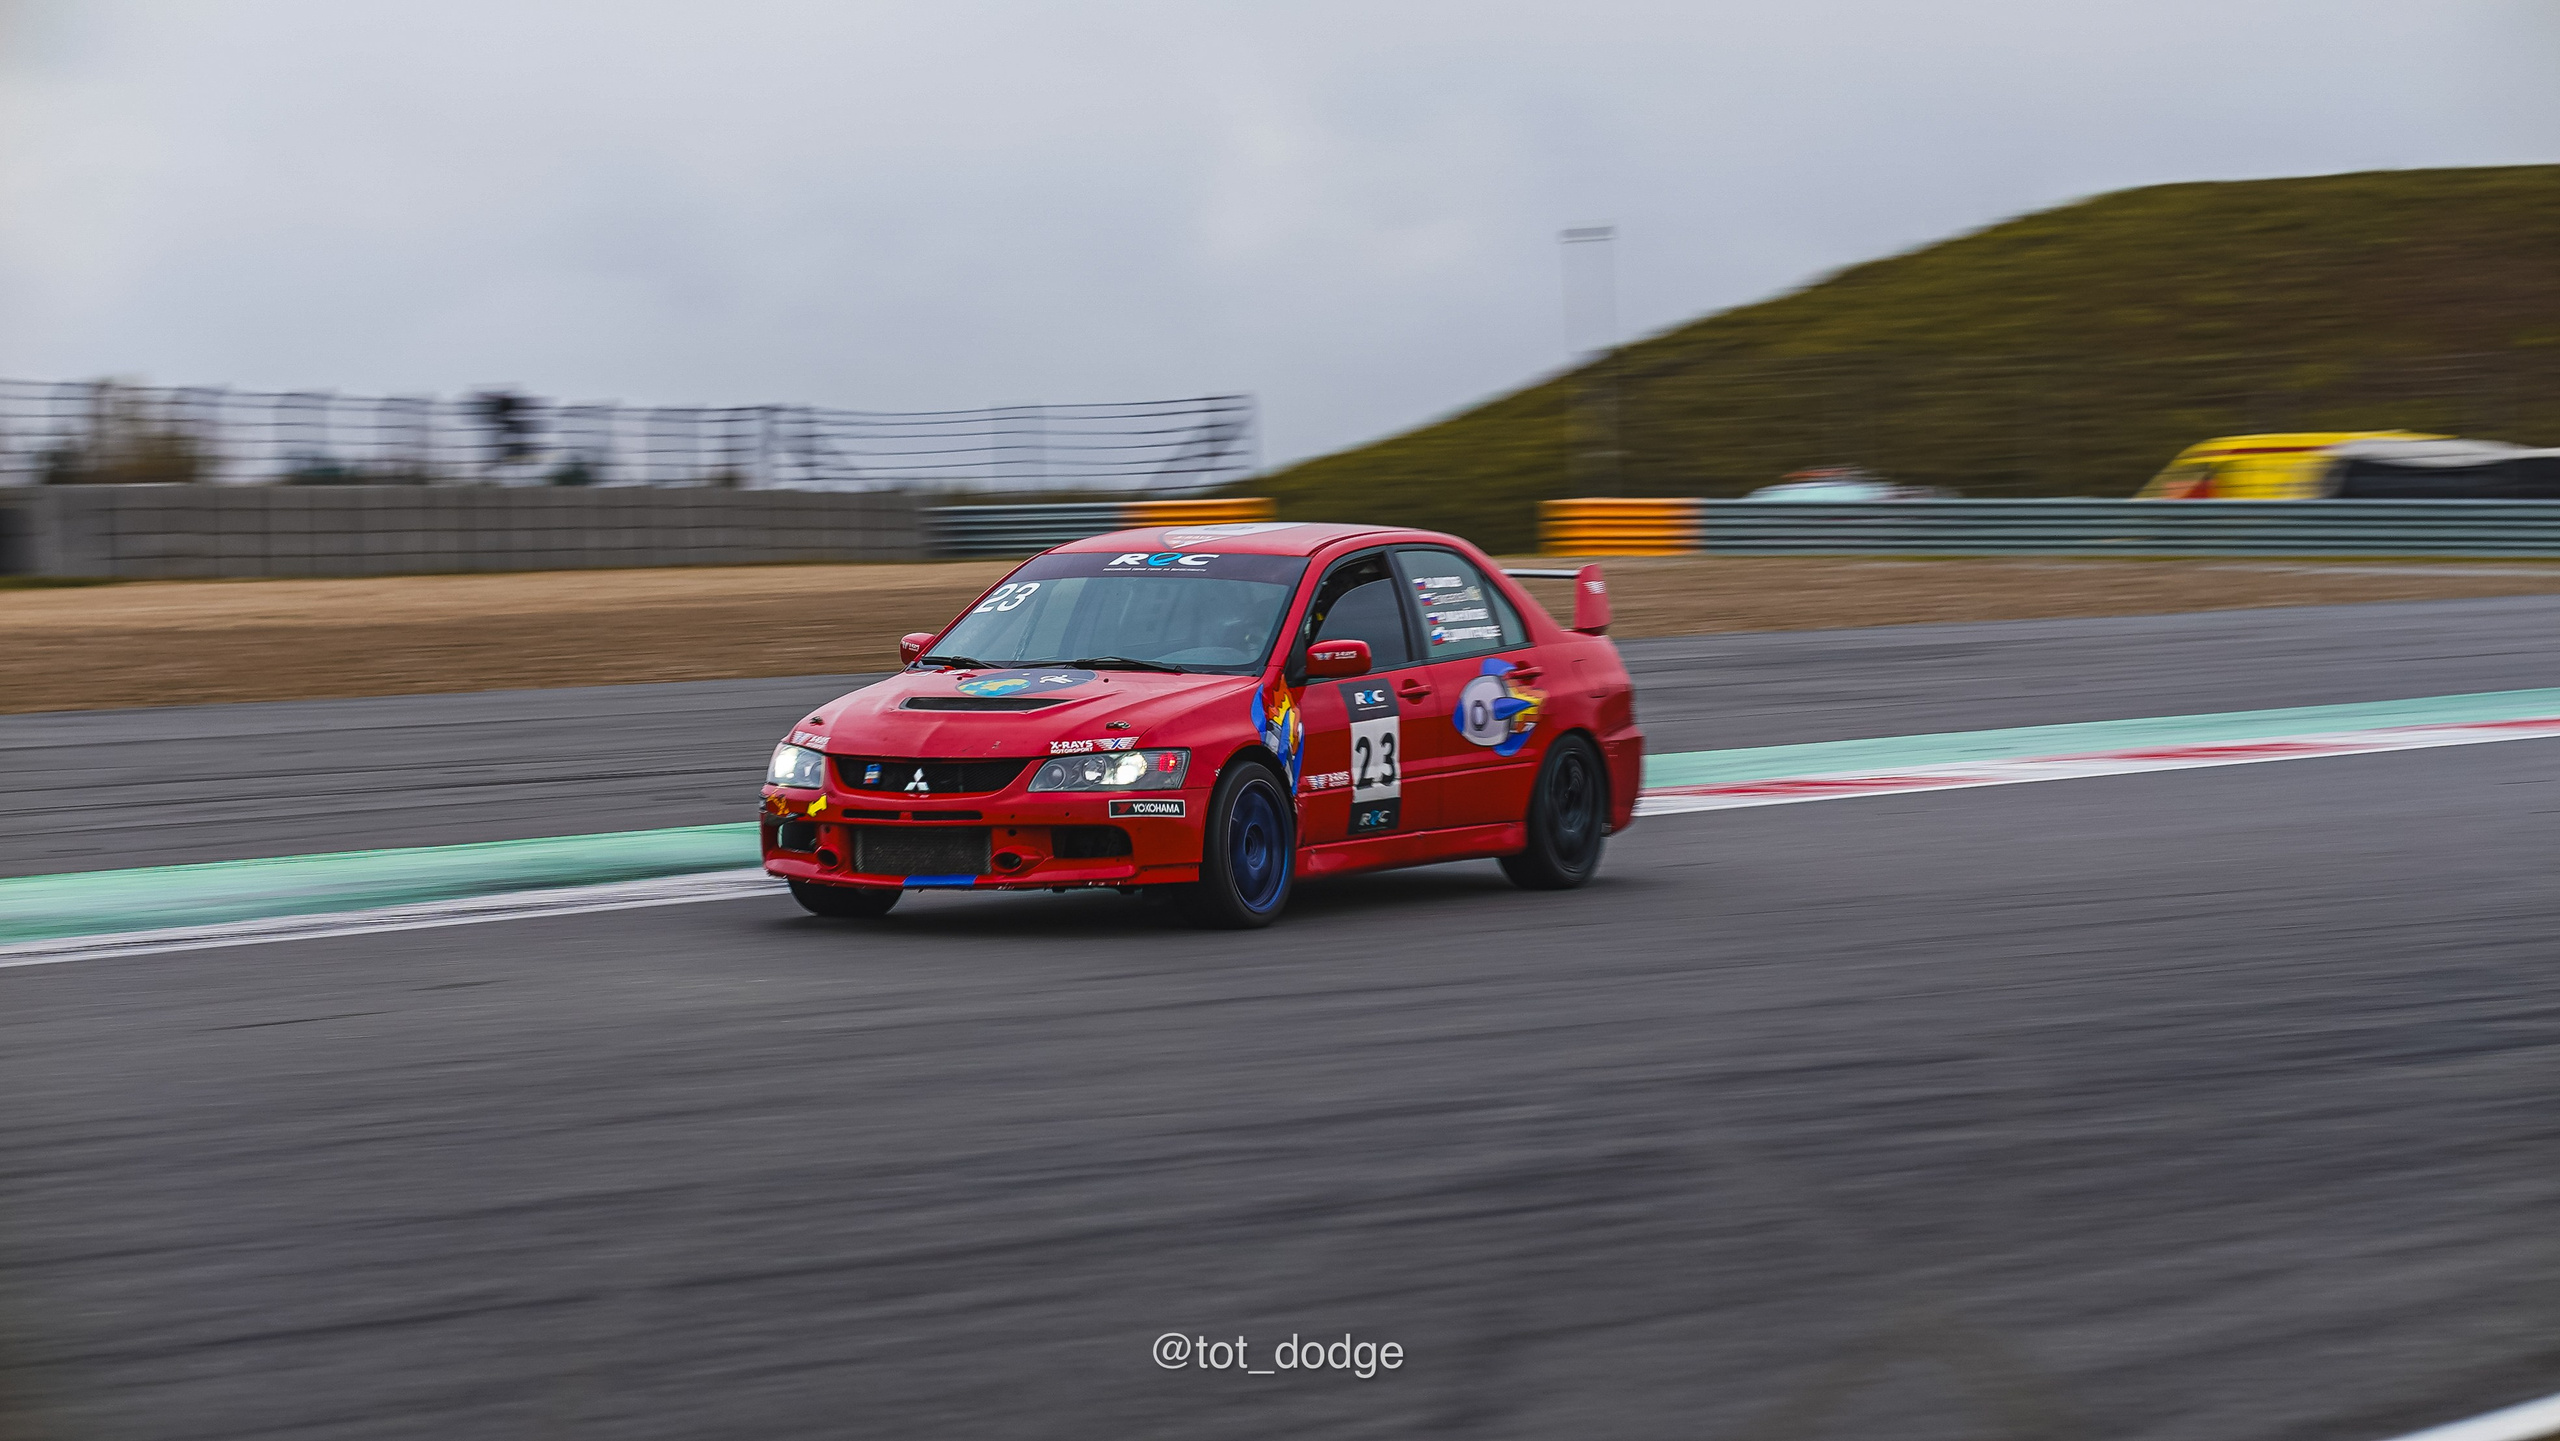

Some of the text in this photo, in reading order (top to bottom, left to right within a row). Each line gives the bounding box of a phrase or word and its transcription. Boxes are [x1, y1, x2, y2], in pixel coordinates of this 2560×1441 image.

[972, 582, 1041, 614] 23
[1049, 740, 1094, 750] X-RAYS
[1355, 732, 1395, 790] 23
[1132, 803, 1180, 814] YOKOHAMA
